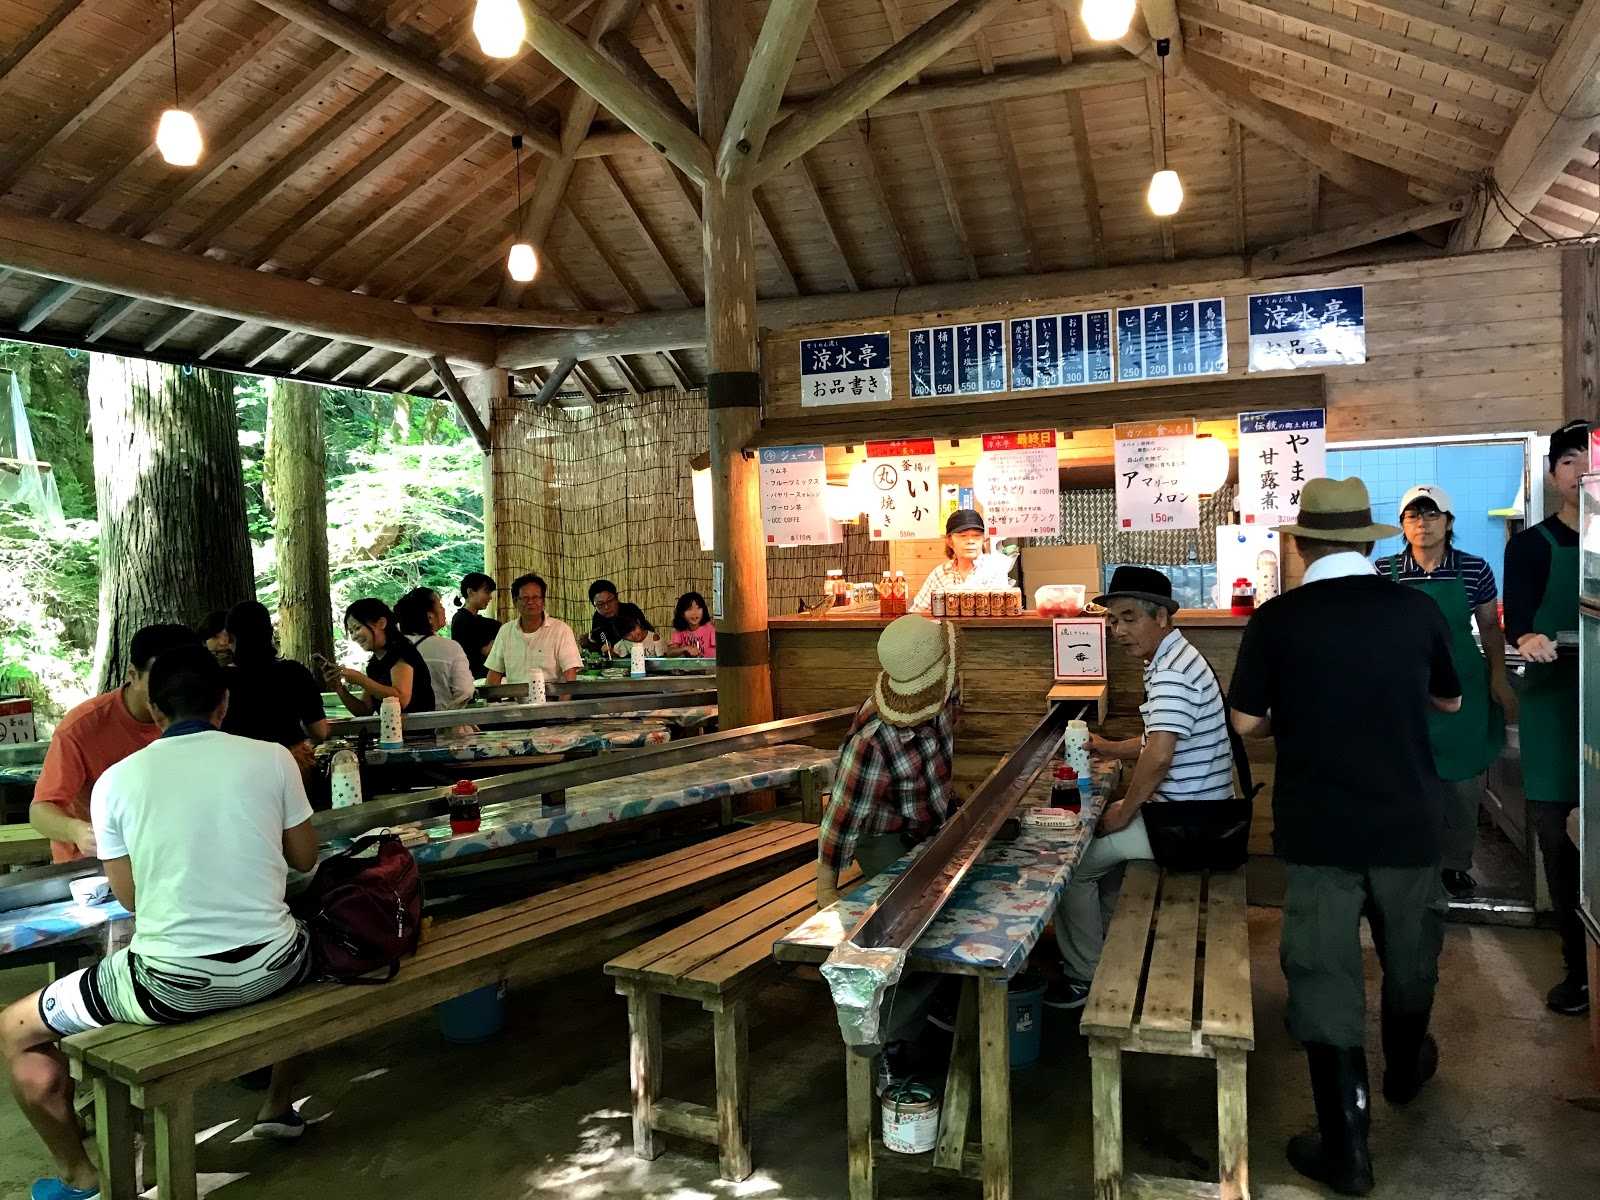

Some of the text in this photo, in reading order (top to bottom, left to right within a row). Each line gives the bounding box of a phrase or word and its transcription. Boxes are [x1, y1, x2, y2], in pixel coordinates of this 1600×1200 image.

[1264, 299, 1347, 329] 涼水亭
[1125, 315, 1137, 355] ビール
[1178, 310, 1189, 354] ジュース
[812, 343, 878, 371] 涼水亭
[1123, 368, 1140, 377] 250
[1150, 365, 1167, 375] 200
[1178, 362, 1194, 372] 110
[1016, 377, 1031, 386] 350
[1066, 373, 1082, 382] 300
[1093, 371, 1109, 380] 320
[813, 375, 878, 397] お品書き
[937, 384, 953, 393] 550
[961, 382, 976, 391] 550
[986, 380, 1001, 389] 150
[1254, 419, 1319, 431] 伝統の郷土料理
[1017, 431, 1051, 445] 最終日
[781, 449, 816, 461] ジュース
[901, 459, 930, 472] 釜揚げ
[770, 478, 820, 486] フルーツミックス
[1259, 447, 1280, 510] 甘露煮
[906, 479, 929, 521] いか
[1153, 492, 1189, 504] メロン
[771, 503, 802, 511] ウーロン茶
[1150, 512, 1174, 523] 150円
[1067, 643, 1092, 662] 一番
